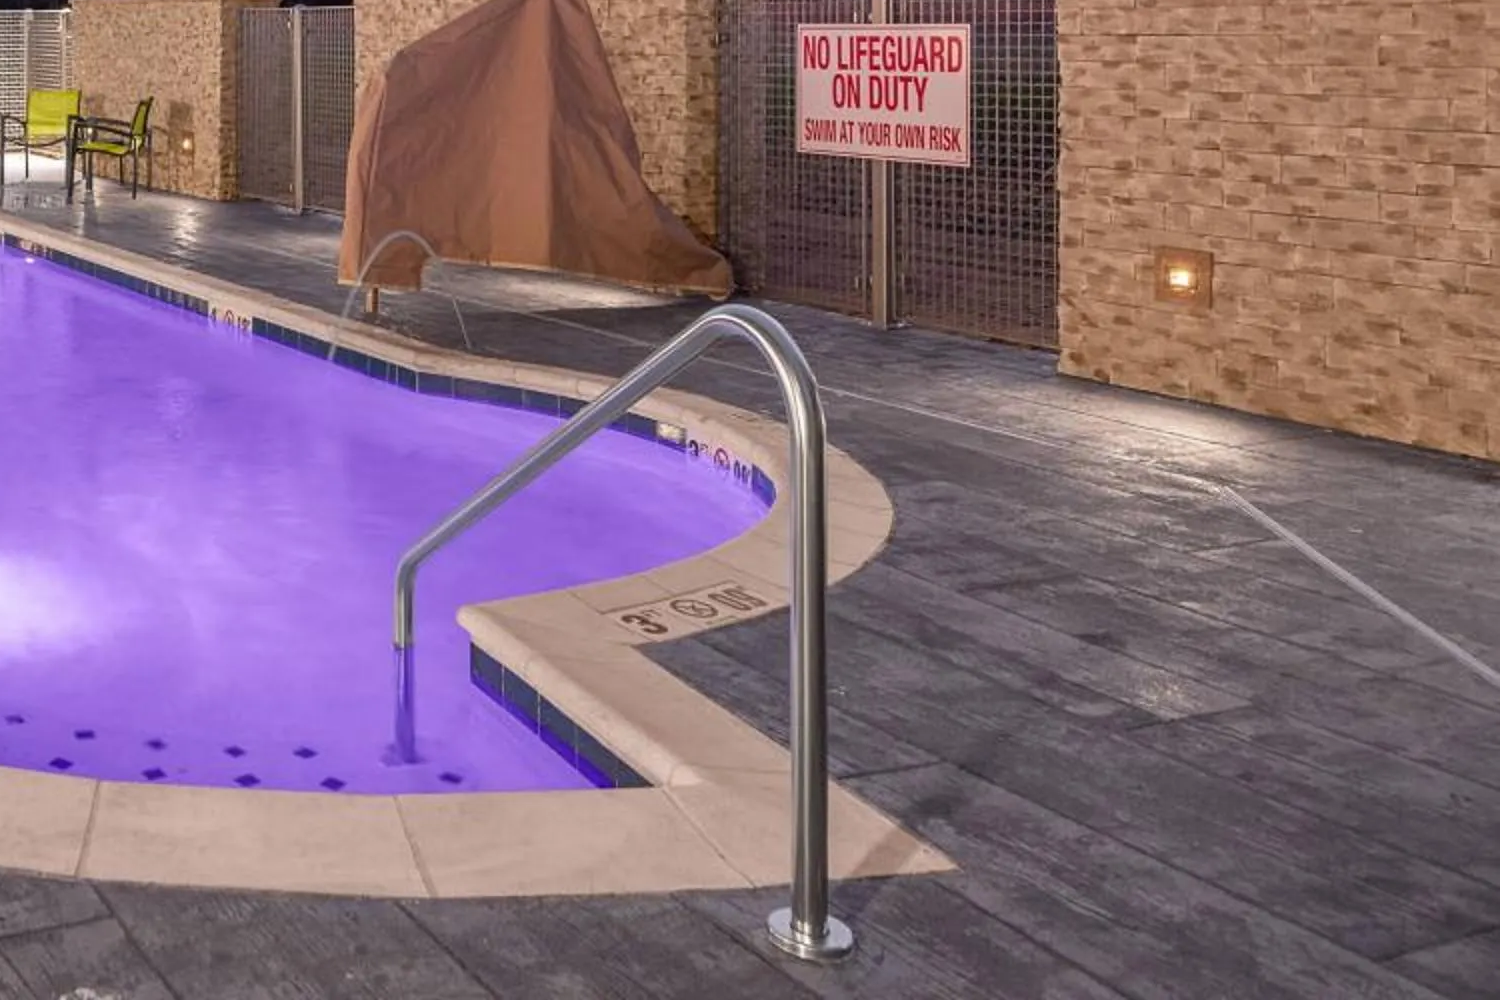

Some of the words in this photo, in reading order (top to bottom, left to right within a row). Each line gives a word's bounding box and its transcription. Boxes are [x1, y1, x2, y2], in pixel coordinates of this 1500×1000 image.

[803, 35, 830, 69] NO
[837, 35, 963, 73] LIFEGUARD
[832, 73, 860, 109] ON
[868, 75, 929, 112] DUTY
[804, 117, 836, 142] SWIM
[839, 121, 855, 145] AT
[858, 122, 891, 147] YOUR
[895, 124, 925, 149] OWN
[929, 126, 962, 153] RISK
